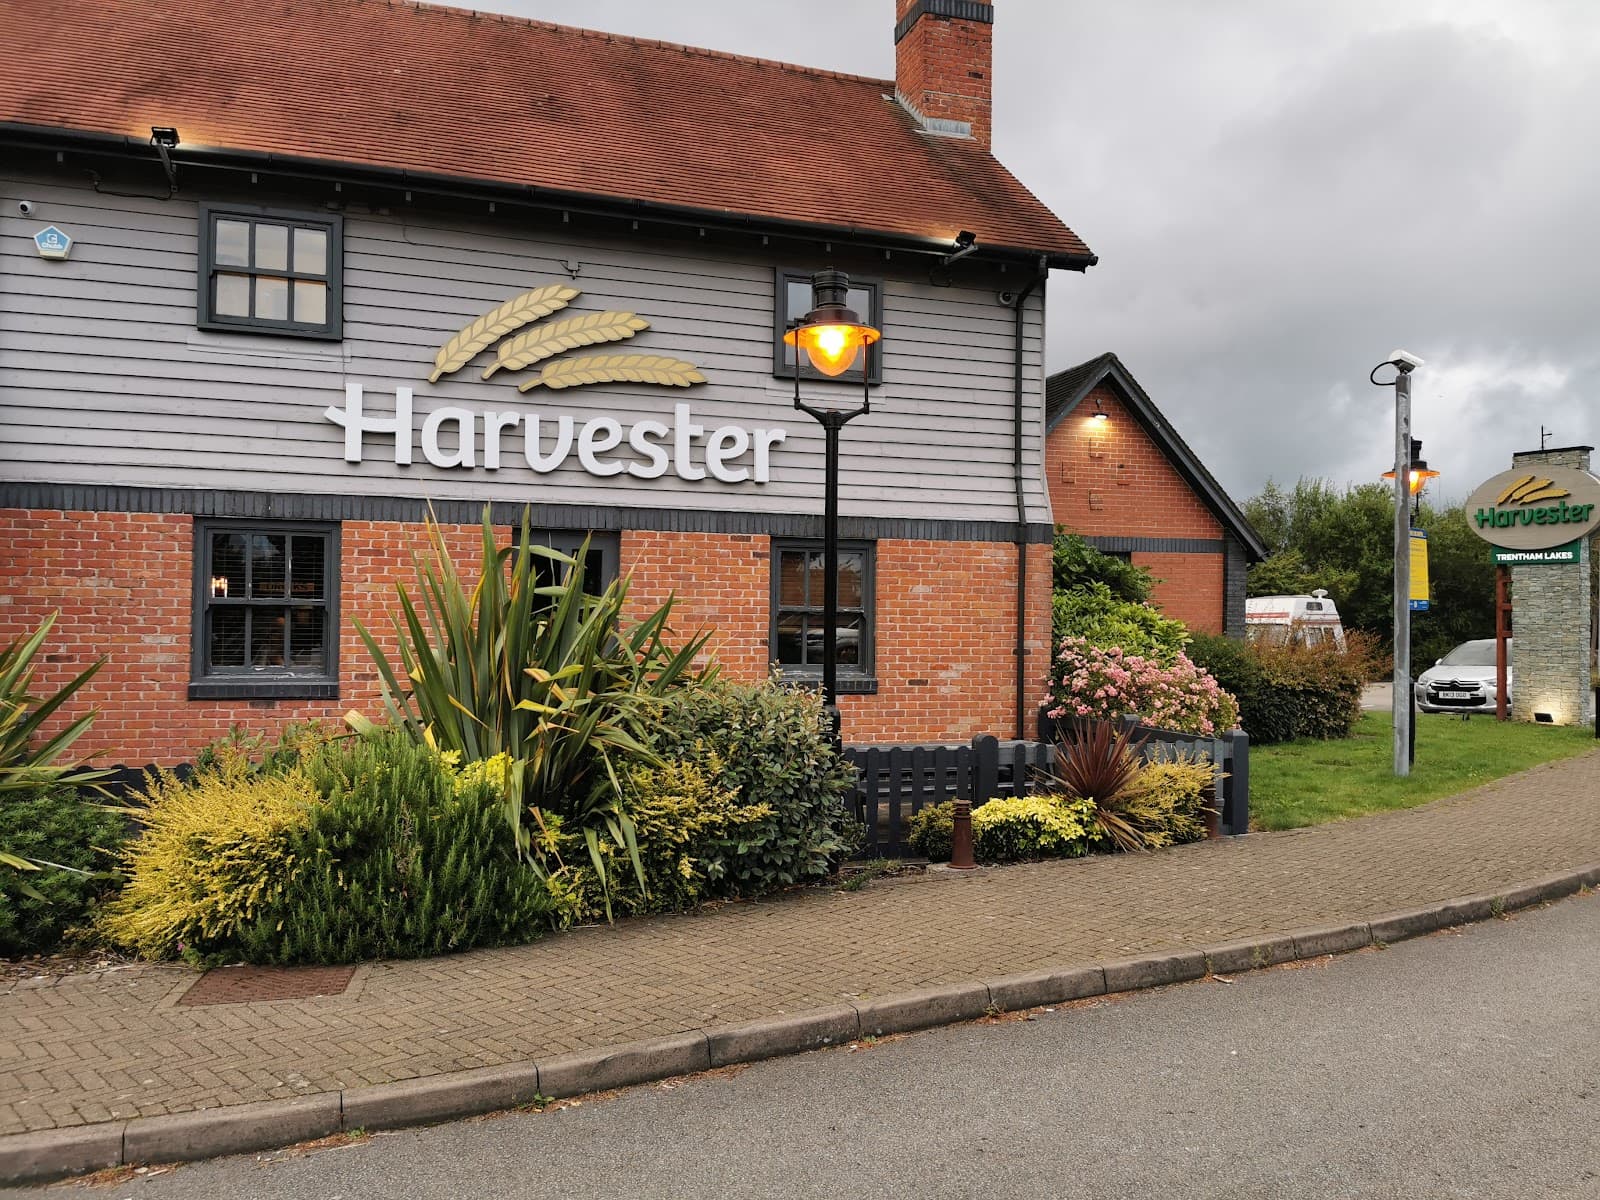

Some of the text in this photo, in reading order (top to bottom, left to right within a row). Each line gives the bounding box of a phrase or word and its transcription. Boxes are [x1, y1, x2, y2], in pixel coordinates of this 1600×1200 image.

[324, 383, 787, 483] Harvester
[1474, 501, 1594, 528] Harvester
[1496, 551, 1573, 561] TRENTHAM LAKES
